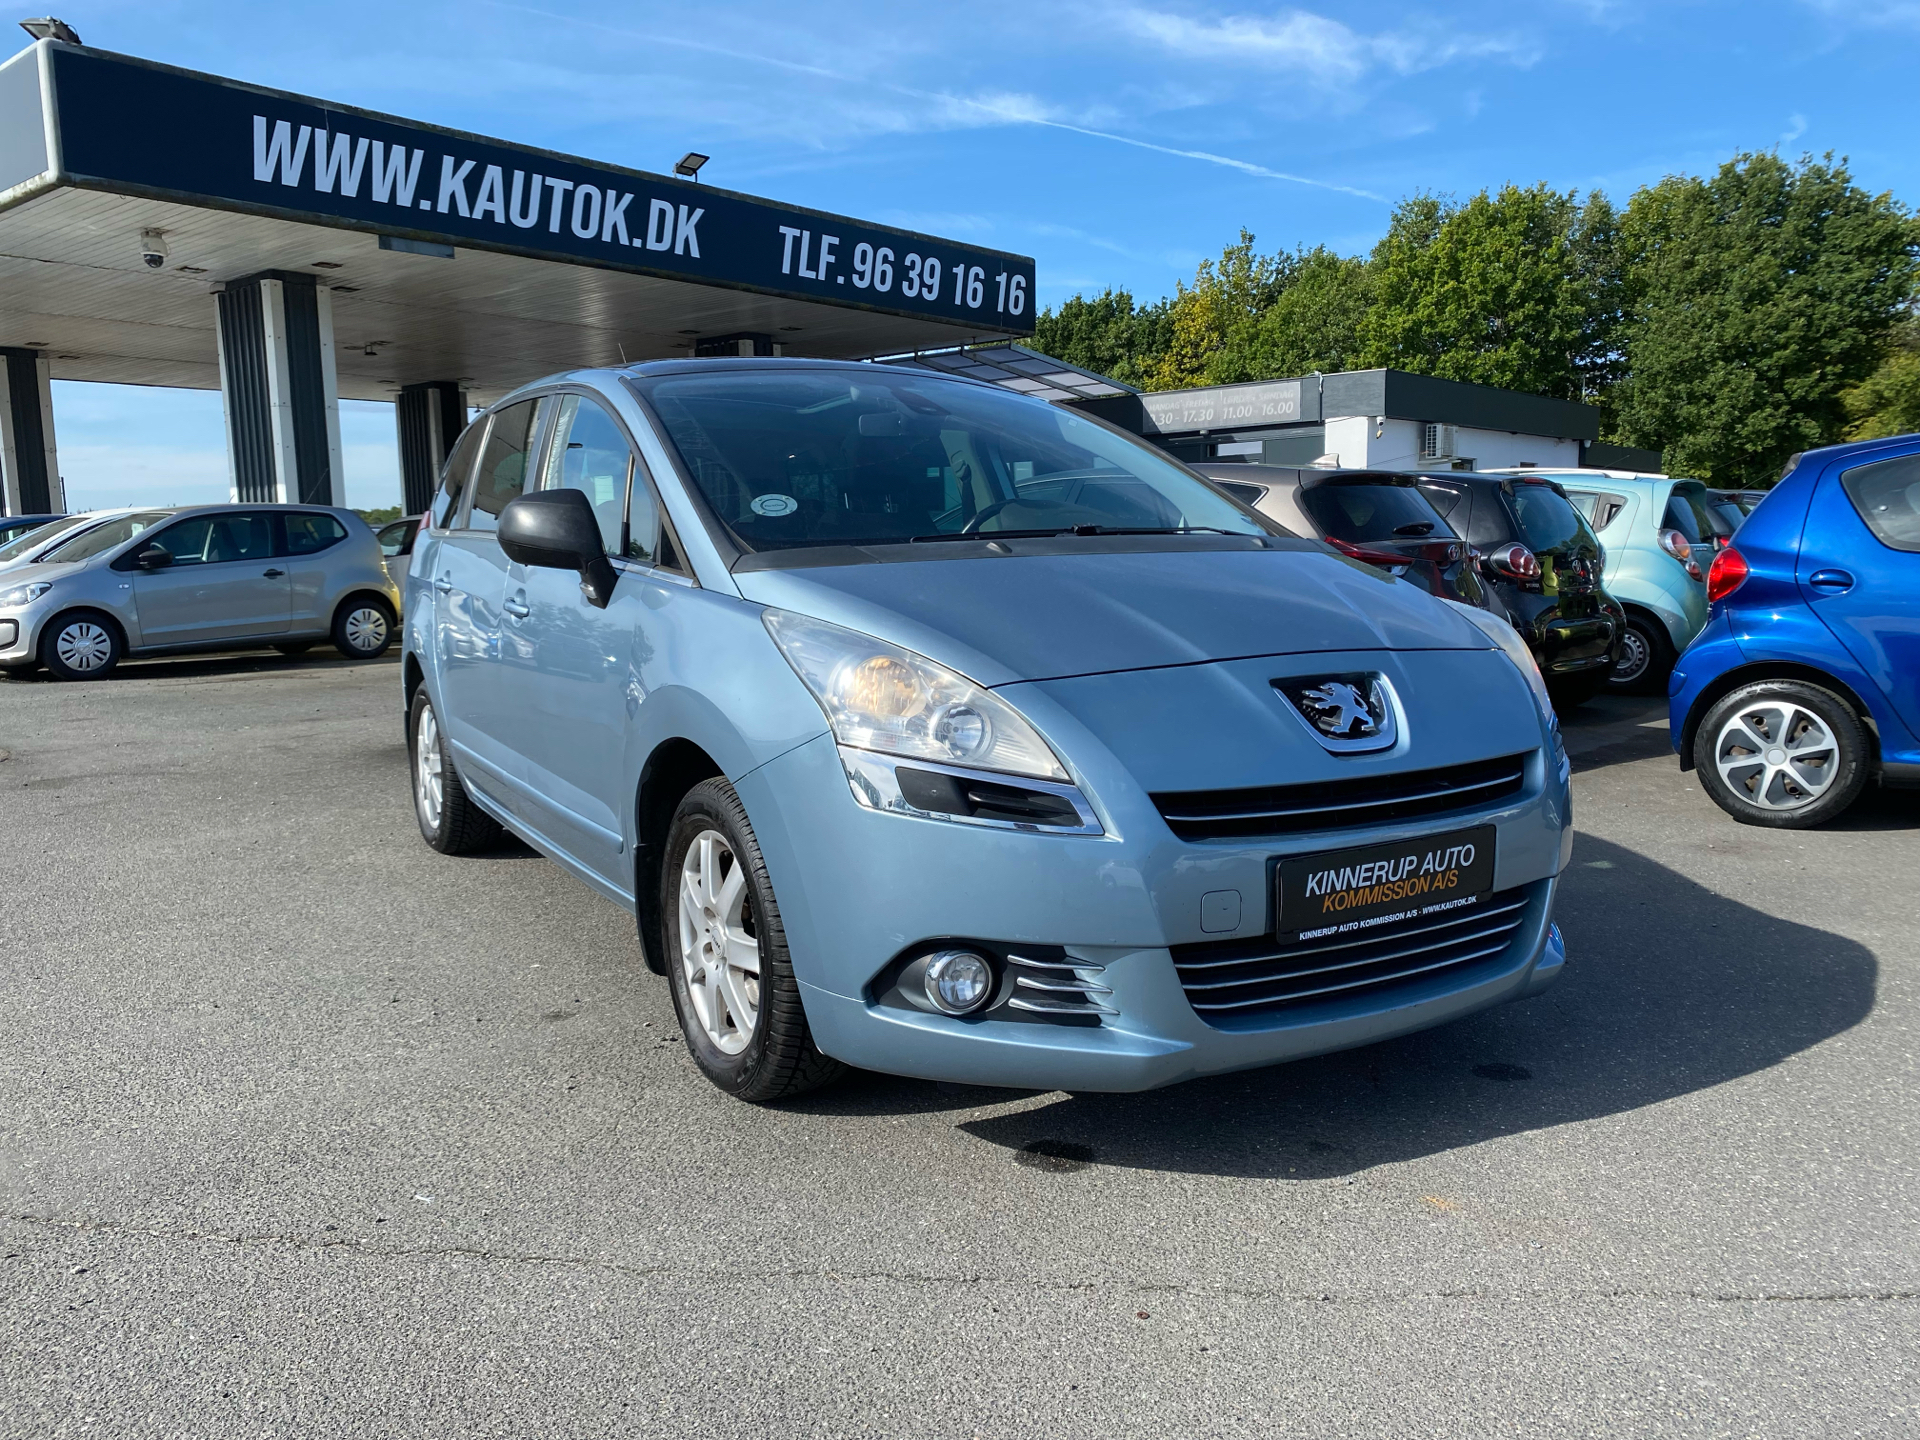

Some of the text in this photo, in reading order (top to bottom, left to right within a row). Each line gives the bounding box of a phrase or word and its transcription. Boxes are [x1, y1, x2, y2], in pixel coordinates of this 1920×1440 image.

[253, 115, 705, 258] WWW.KAUTOK.DK
[779, 225, 1026, 316] TLF. 96 39 16 16
[1183, 408, 1214, 423] 17.30
[1223, 404, 1253, 419] 11.00
[1262, 401, 1294, 416] 16.00
[1305, 843, 1475, 898] KINNERUP AUTO
[1322, 869, 1459, 913] KOMMISSION A/S
[1299, 926, 1338, 940] KINNERUP
[1338, 921, 1359, 933] AUTO
[1360, 911, 1405, 928] KOMMISSION
[1406, 909, 1418, 919] A/S
[1422, 895, 1477, 915] WWW.KAUTOK.DK
